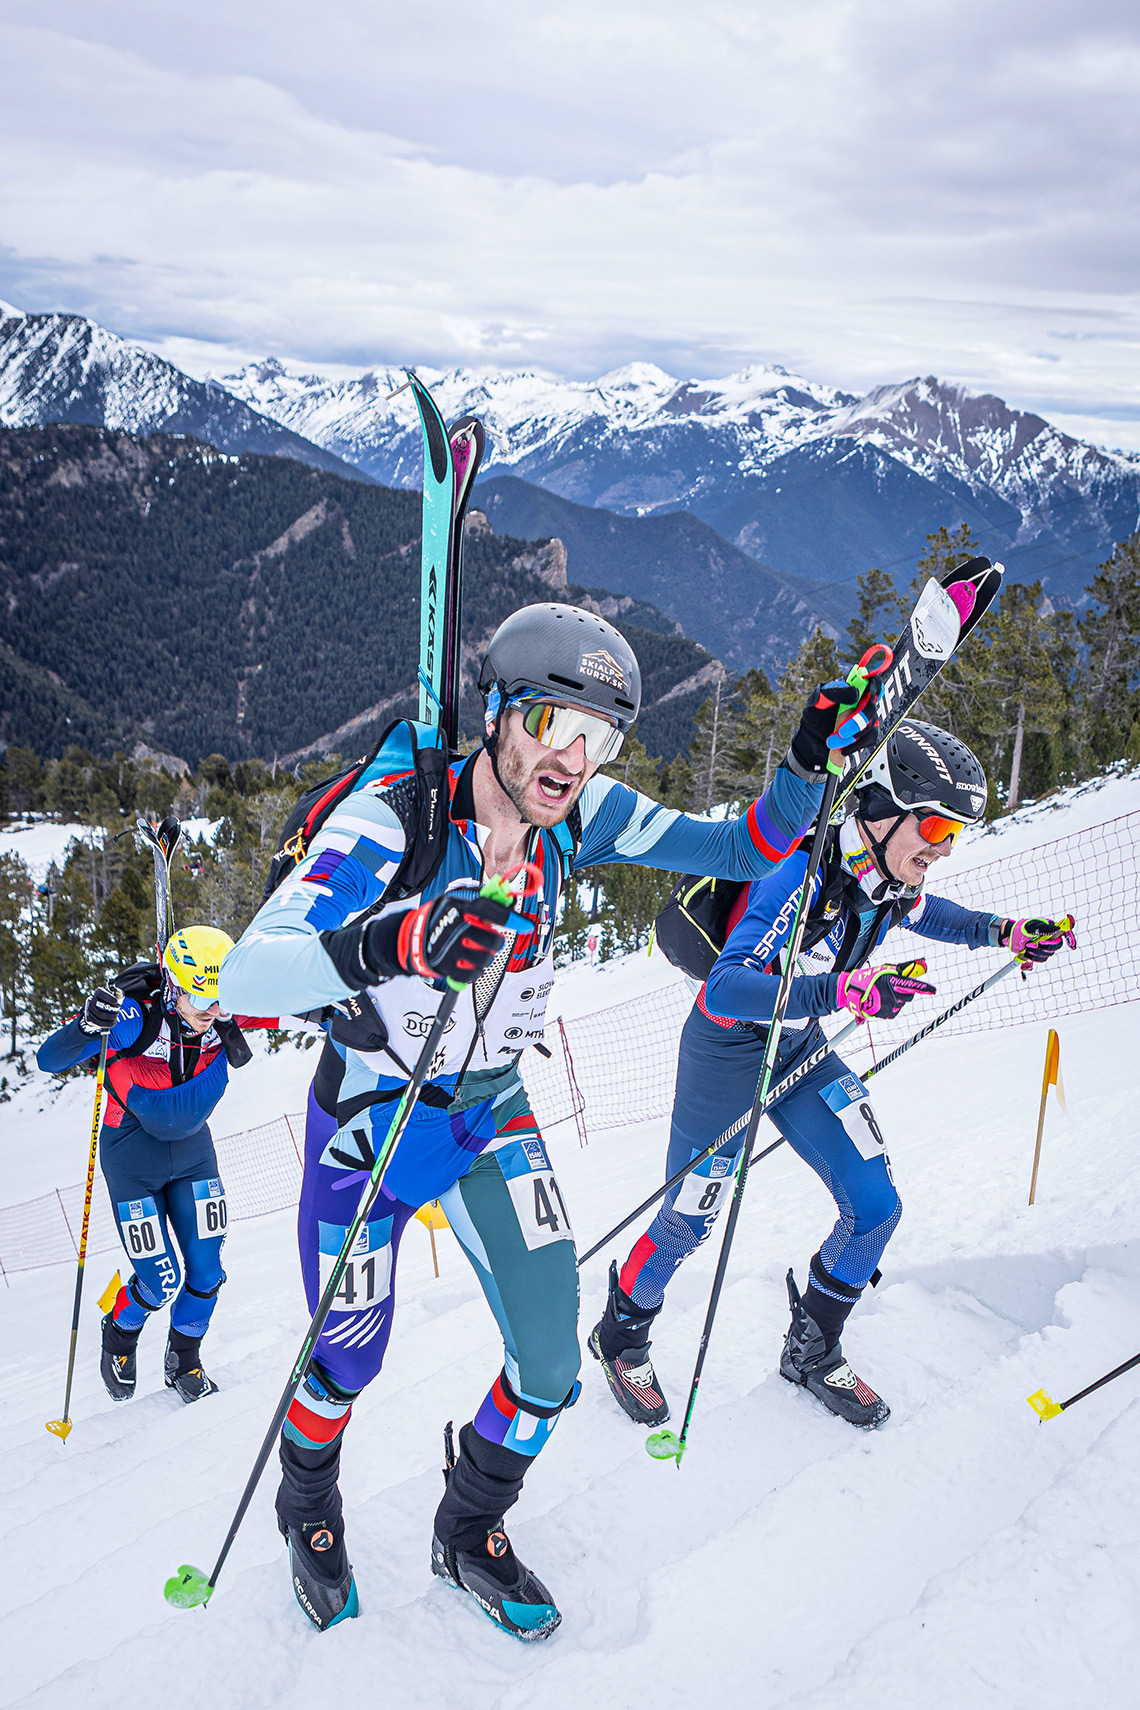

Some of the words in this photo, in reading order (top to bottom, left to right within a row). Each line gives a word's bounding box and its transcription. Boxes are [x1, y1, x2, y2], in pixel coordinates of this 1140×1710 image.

[579, 665, 623, 690] KURZY.SK
[581, 658, 615, 676] SKIALP
[896, 725, 954, 785] DYNAFIT
[858, 1102, 884, 1145] 8
[81, 1211, 91, 1241] ATK
[91, 1102, 102, 1160] carbon
[205, 1198, 228, 1232] 60
[532, 1177, 571, 1233] 41
[697, 1181, 722, 1211] 8
[128, 1221, 156, 1254] 60
[335, 1256, 376, 1305] 41
